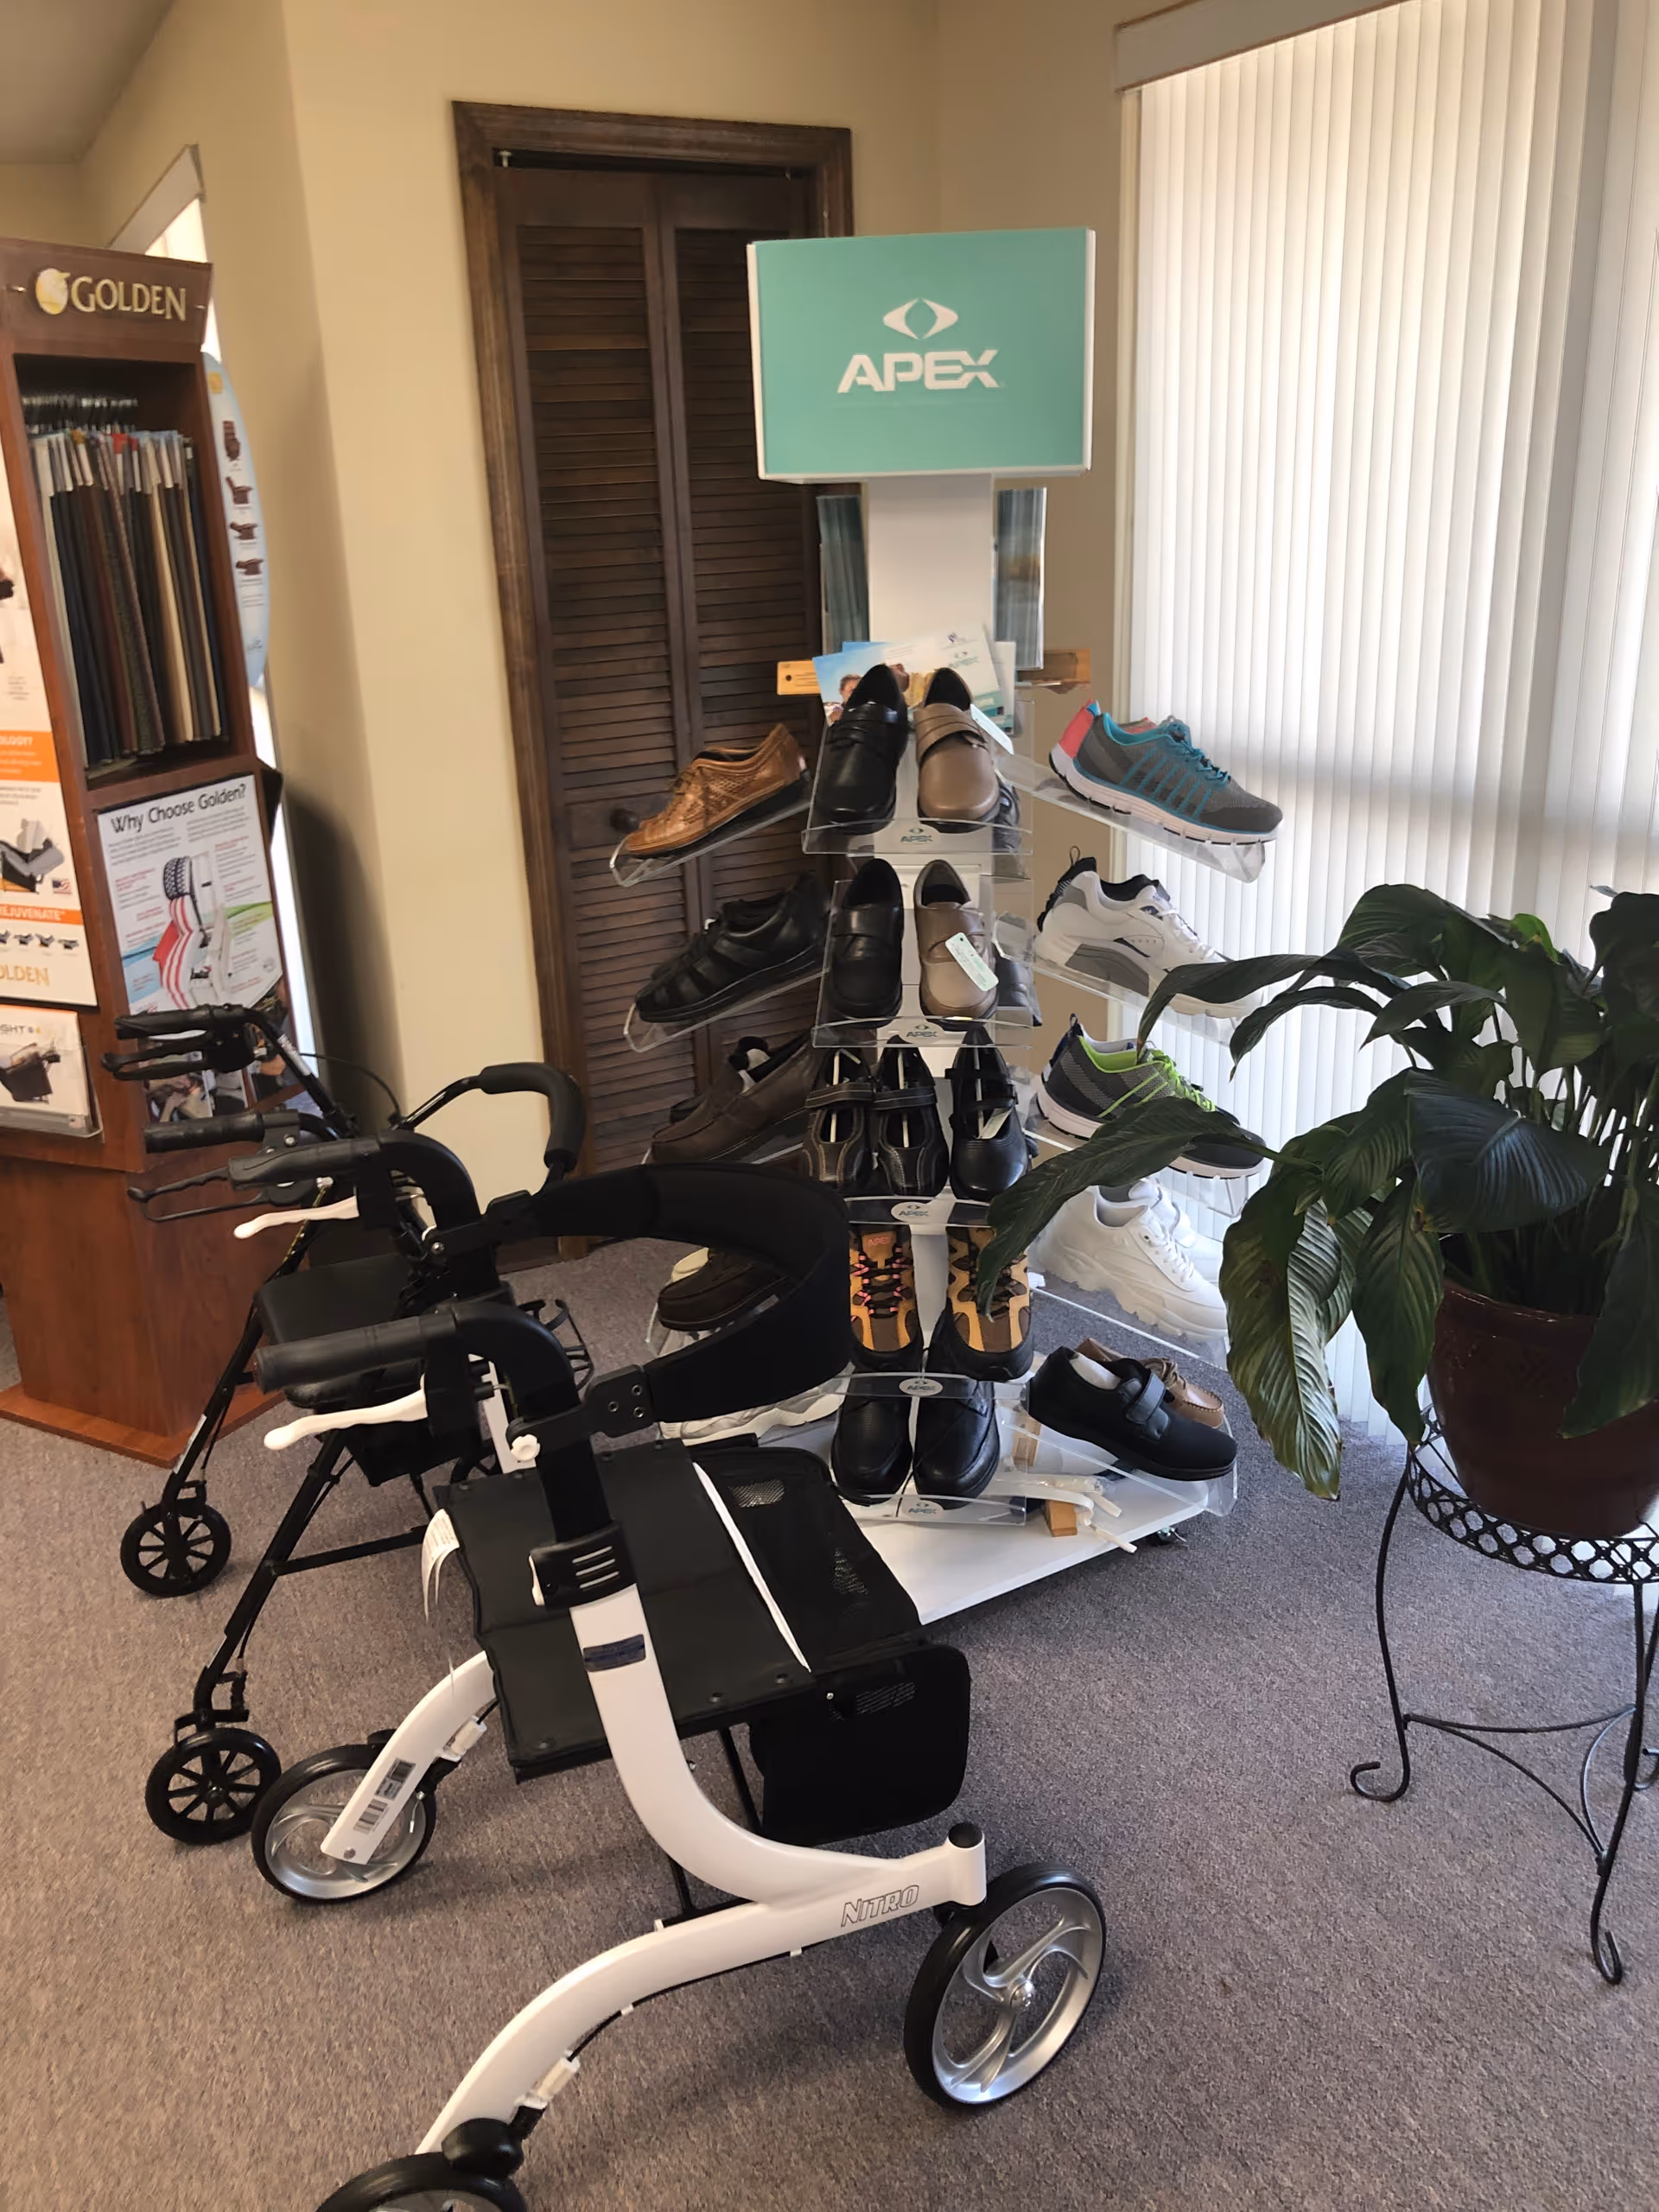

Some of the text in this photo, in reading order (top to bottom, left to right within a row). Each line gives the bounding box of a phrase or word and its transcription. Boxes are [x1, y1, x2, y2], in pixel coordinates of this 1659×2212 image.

[71, 276, 187, 321] GOLDEN
[836, 348, 1000, 393] APEX
[111, 782, 247, 834] Why Choose Golden?
[899, 835, 934, 843] APEX
[840, 1885, 919, 1928] NITRO
